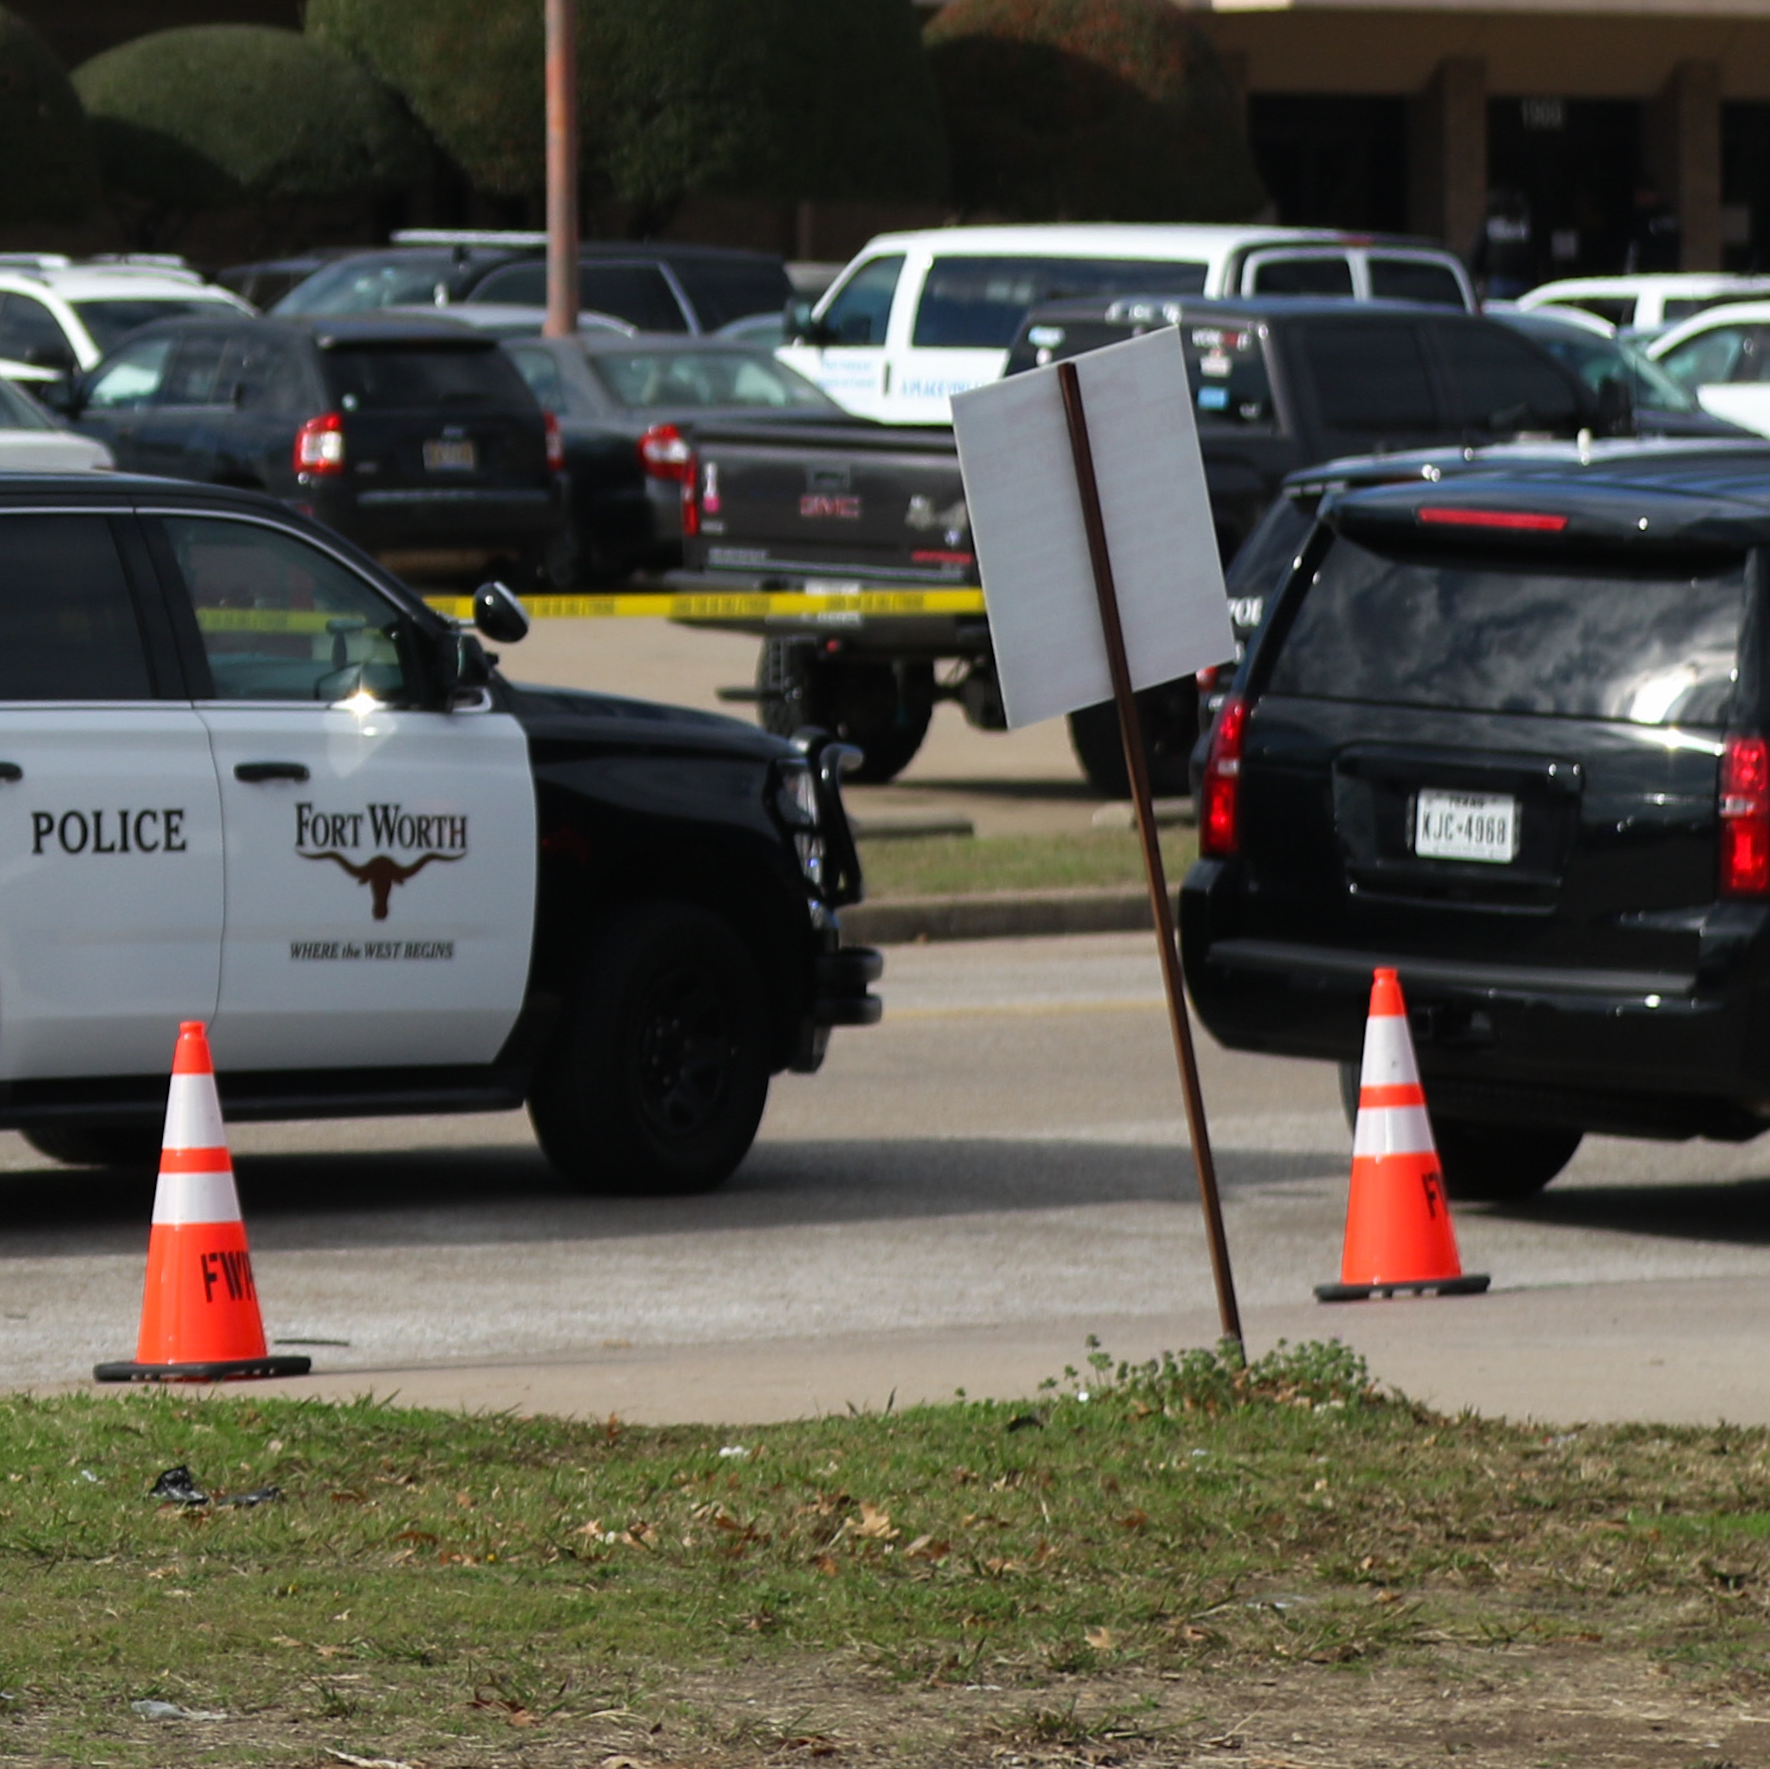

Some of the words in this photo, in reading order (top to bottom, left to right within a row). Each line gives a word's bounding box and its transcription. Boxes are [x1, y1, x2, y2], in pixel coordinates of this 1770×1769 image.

[799, 496, 860, 518] GMC
[31, 808, 187, 855] POLICE
[290, 942, 339, 959] WHERE
[341, 941, 360, 959] the
[364, 941, 402, 959] WEST
[404, 941, 454, 959] BEGINS
